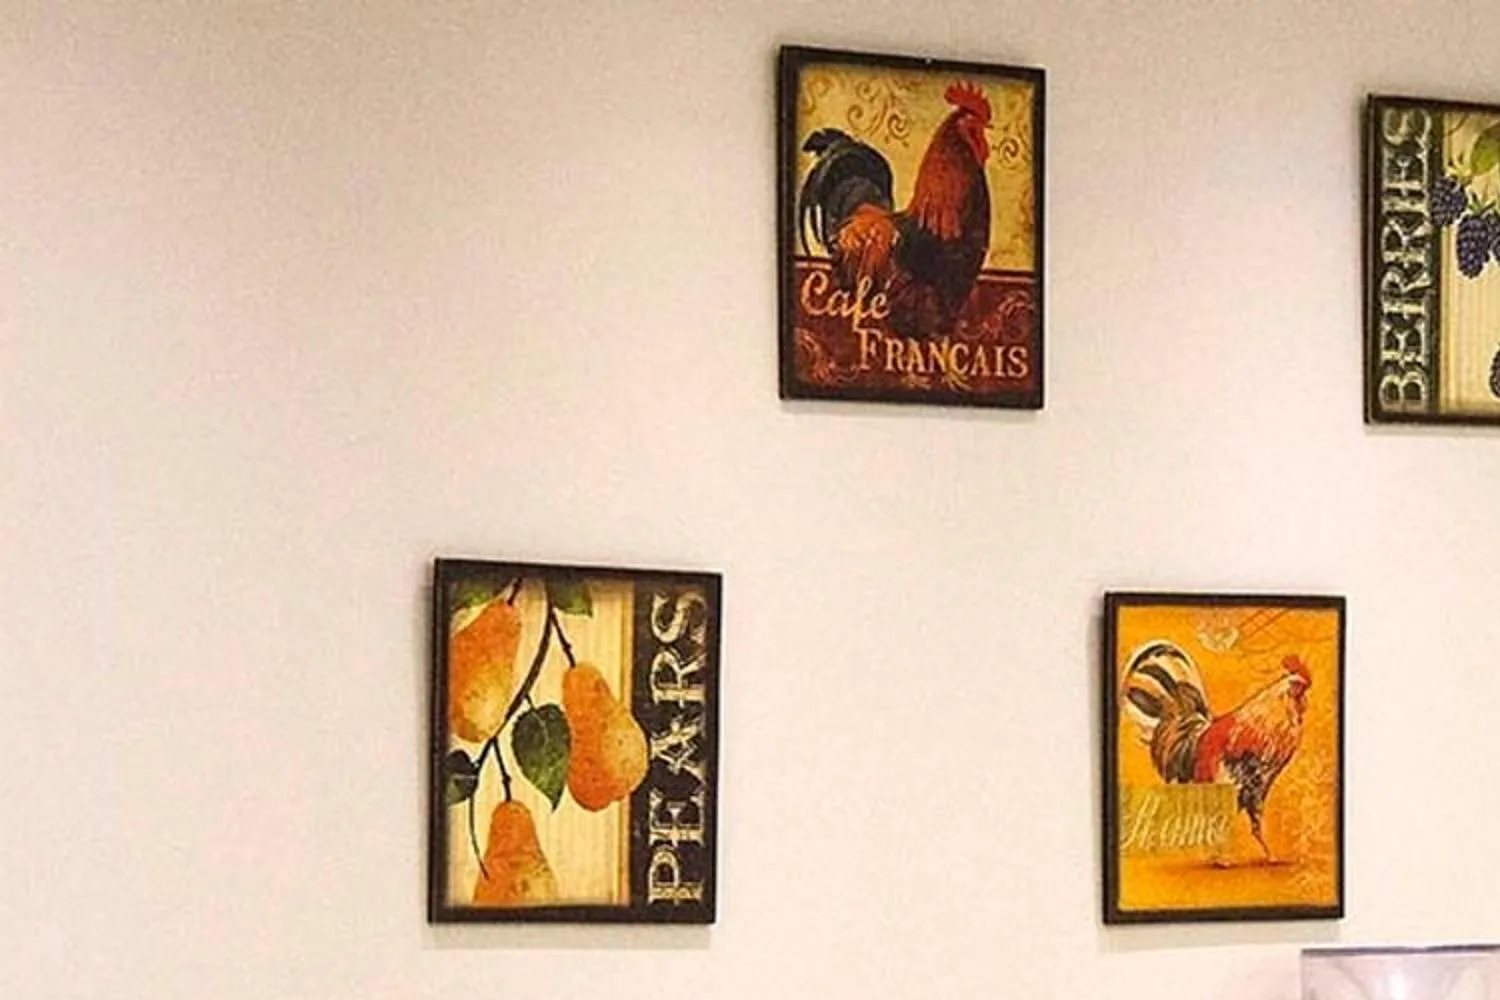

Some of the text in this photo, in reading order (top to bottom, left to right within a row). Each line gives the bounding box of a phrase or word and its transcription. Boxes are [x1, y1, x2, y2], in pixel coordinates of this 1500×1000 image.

[801, 269, 891, 330] Café
[1379, 109, 1434, 406] BERRIES
[648, 591, 707, 905] PEARS
